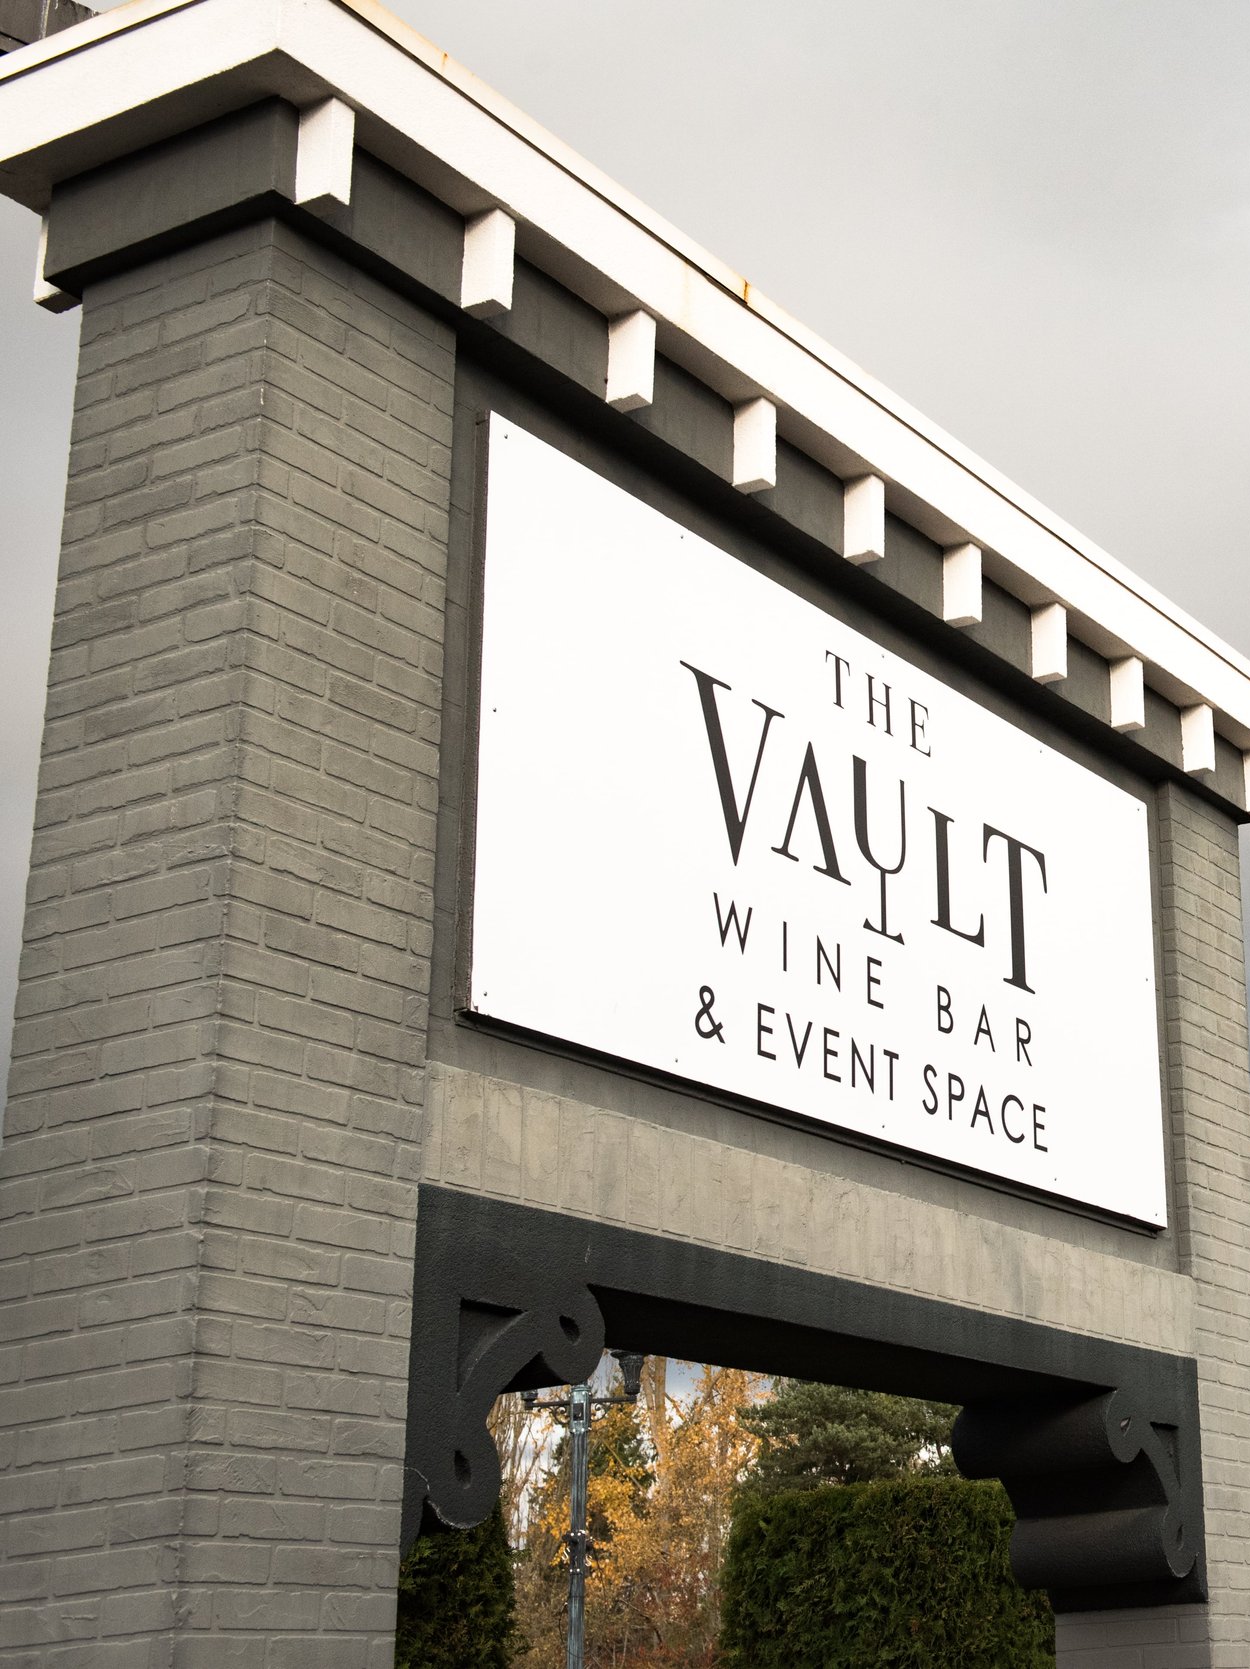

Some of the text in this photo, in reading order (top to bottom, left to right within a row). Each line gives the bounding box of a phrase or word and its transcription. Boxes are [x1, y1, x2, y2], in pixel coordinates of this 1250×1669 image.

[825, 649, 931, 758] THE
[679, 660, 1048, 995] VAULT
[713, 892, 1033, 1067] WINE BAR
[694, 985, 1048, 1153] & EVENT SPACE
